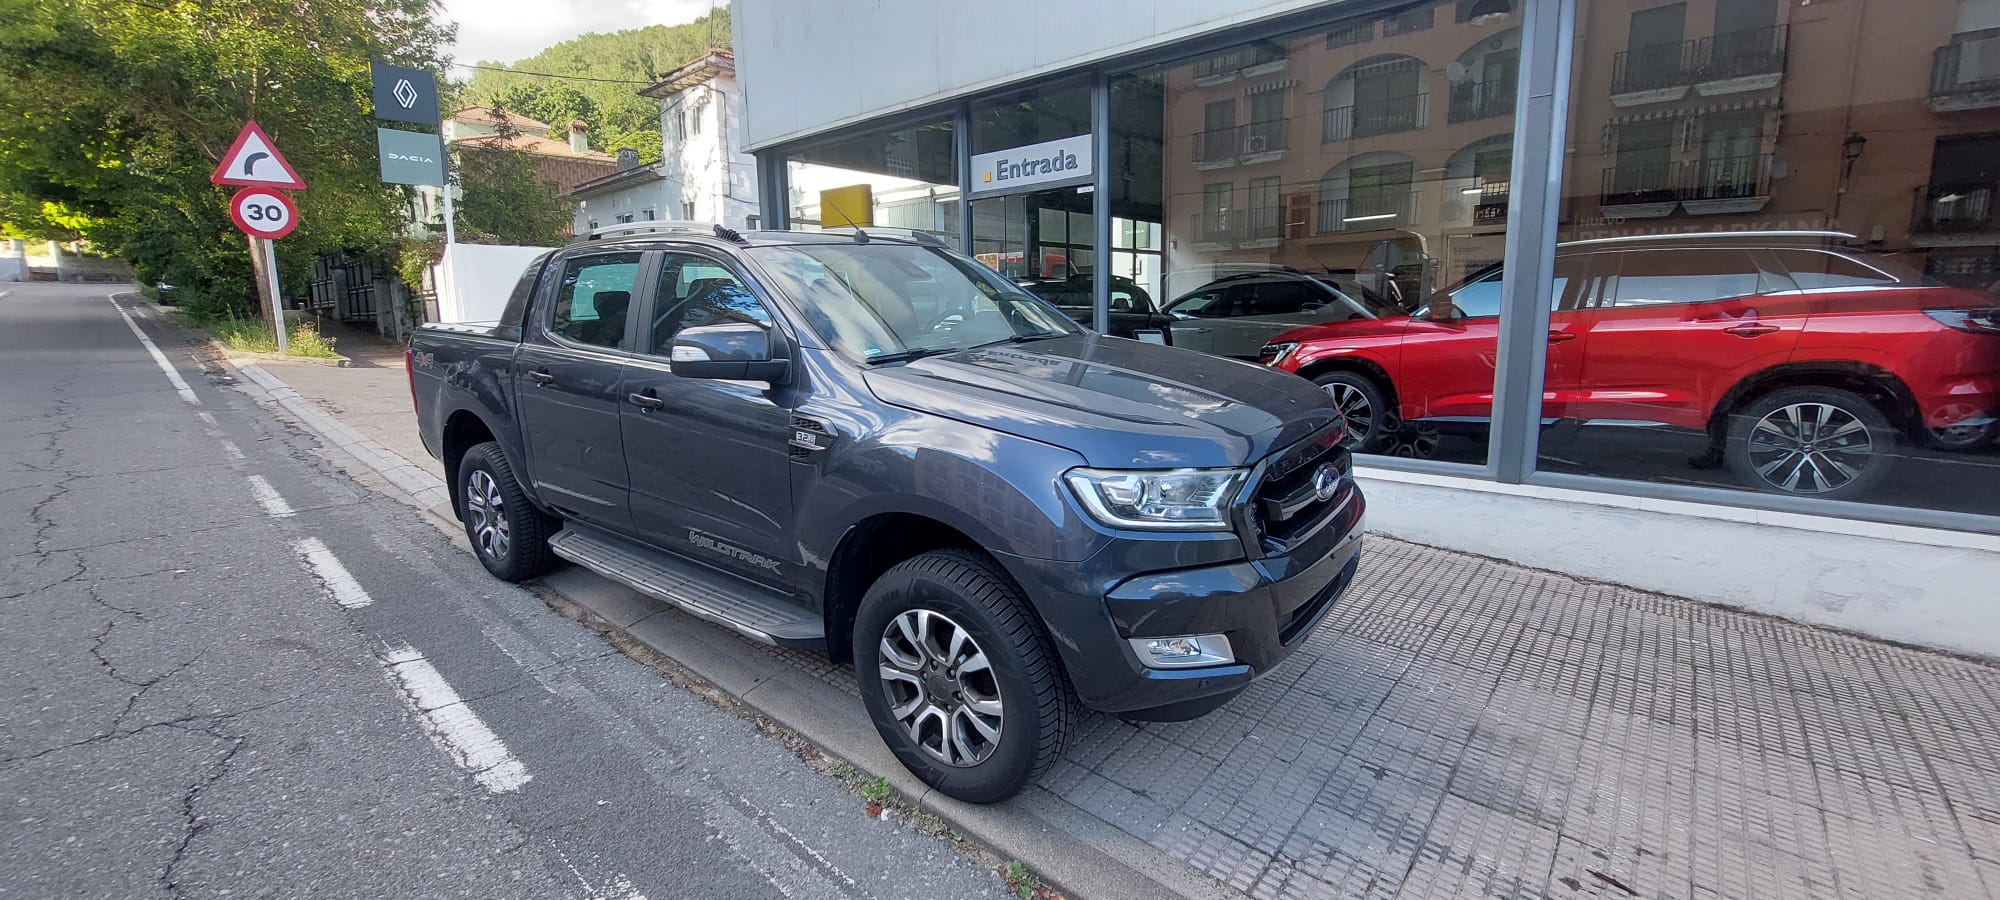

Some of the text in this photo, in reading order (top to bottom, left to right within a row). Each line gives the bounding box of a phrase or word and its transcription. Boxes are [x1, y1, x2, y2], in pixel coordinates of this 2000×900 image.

[388, 153, 434, 163] DACIA
[996, 149, 1078, 180] Entrada
[247, 203, 282, 221] 30
[1580, 216, 1625, 227] NUEVO
[689, 531, 783, 576] WILDTRAK
